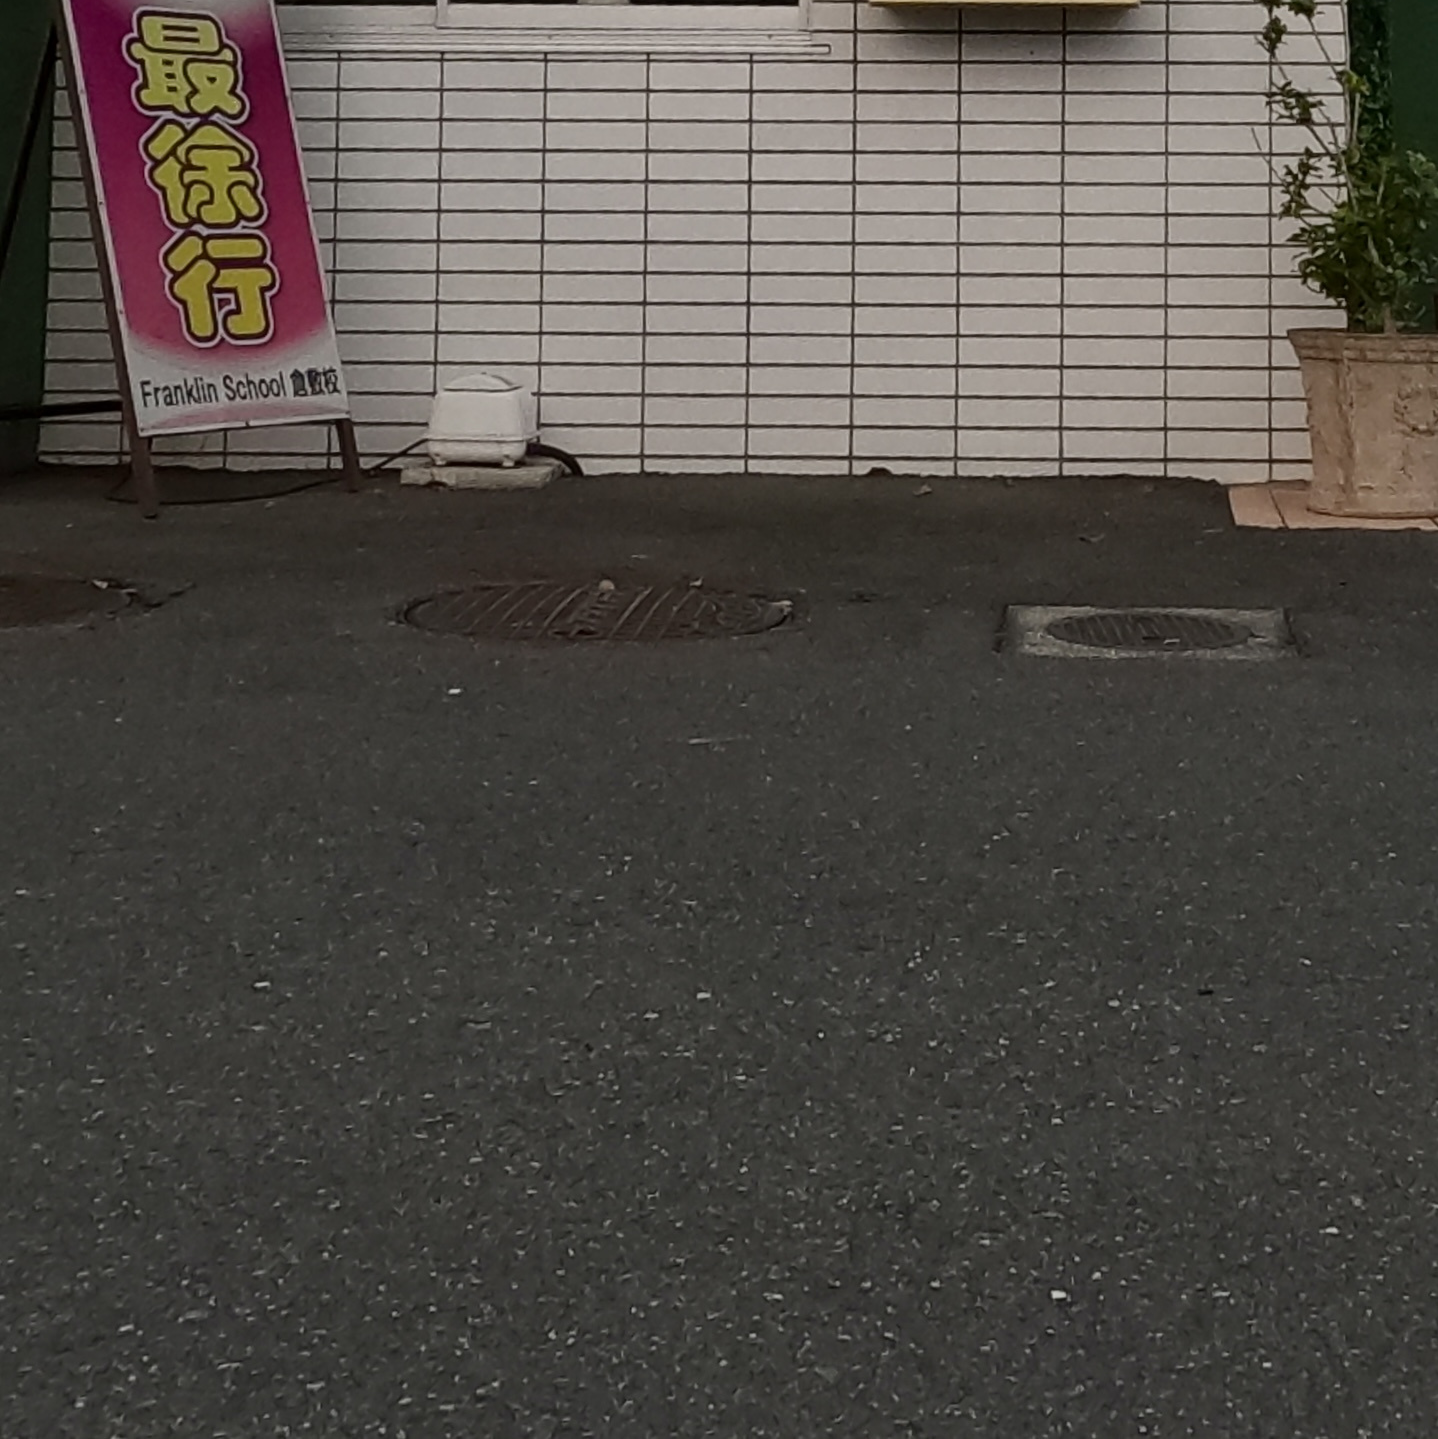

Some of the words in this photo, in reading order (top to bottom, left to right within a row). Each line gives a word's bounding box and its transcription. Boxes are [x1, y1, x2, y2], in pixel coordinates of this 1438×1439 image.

[126, 12, 276, 345] 最徐行
[140, 377, 219, 408] Franklin
[223, 371, 286, 401] School
